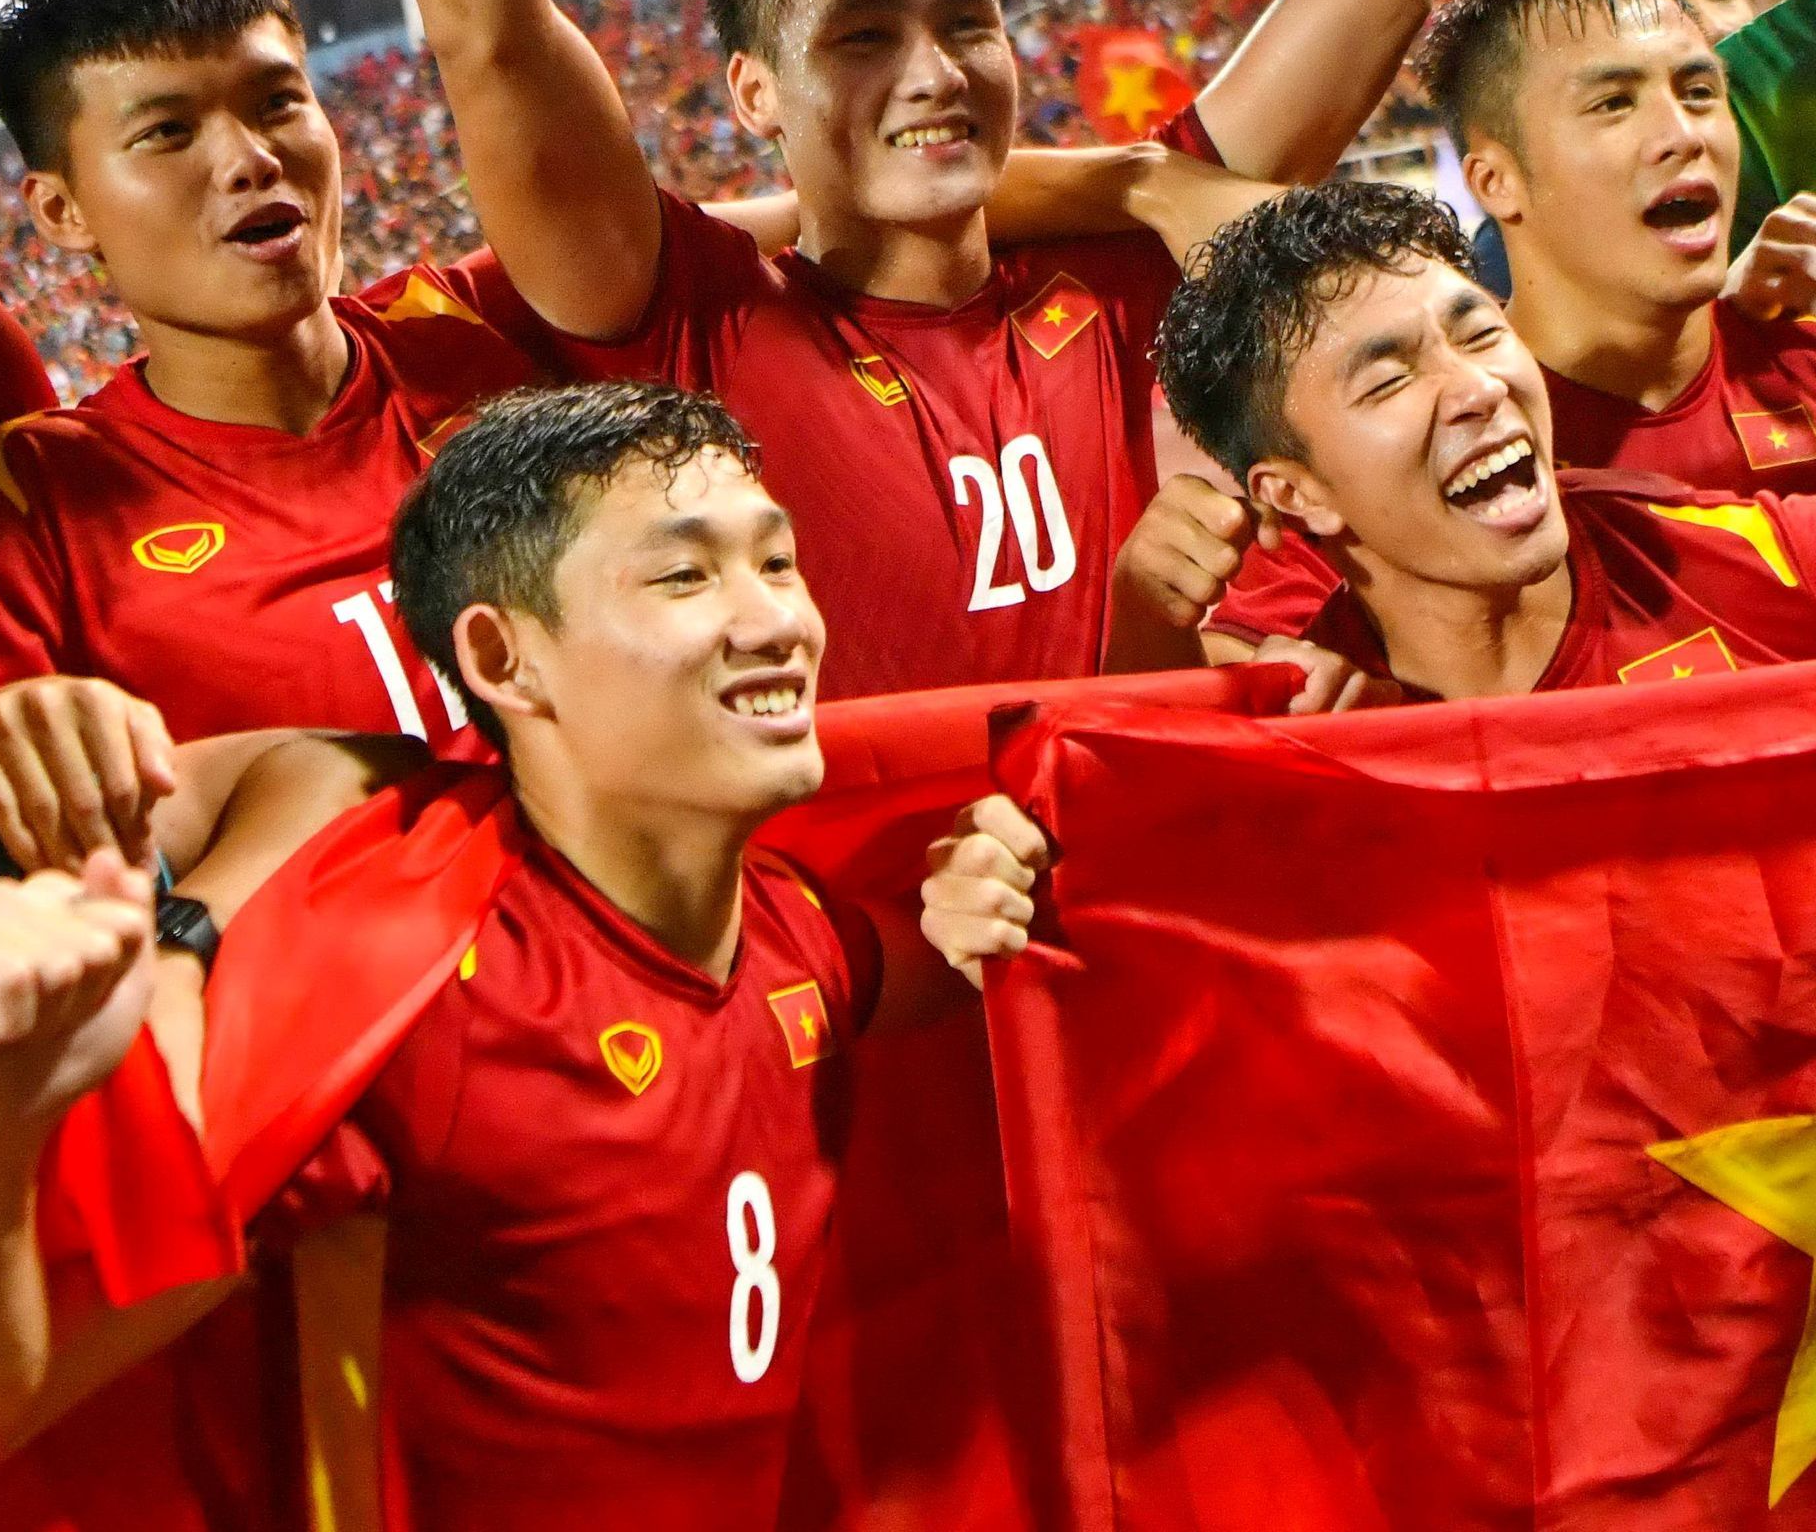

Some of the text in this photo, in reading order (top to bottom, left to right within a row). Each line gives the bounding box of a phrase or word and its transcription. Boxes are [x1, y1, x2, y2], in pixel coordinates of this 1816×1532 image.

[948, 434, 1077, 612] 20
[331, 580, 470, 744] 1
[726, 1171, 781, 1383] 8
